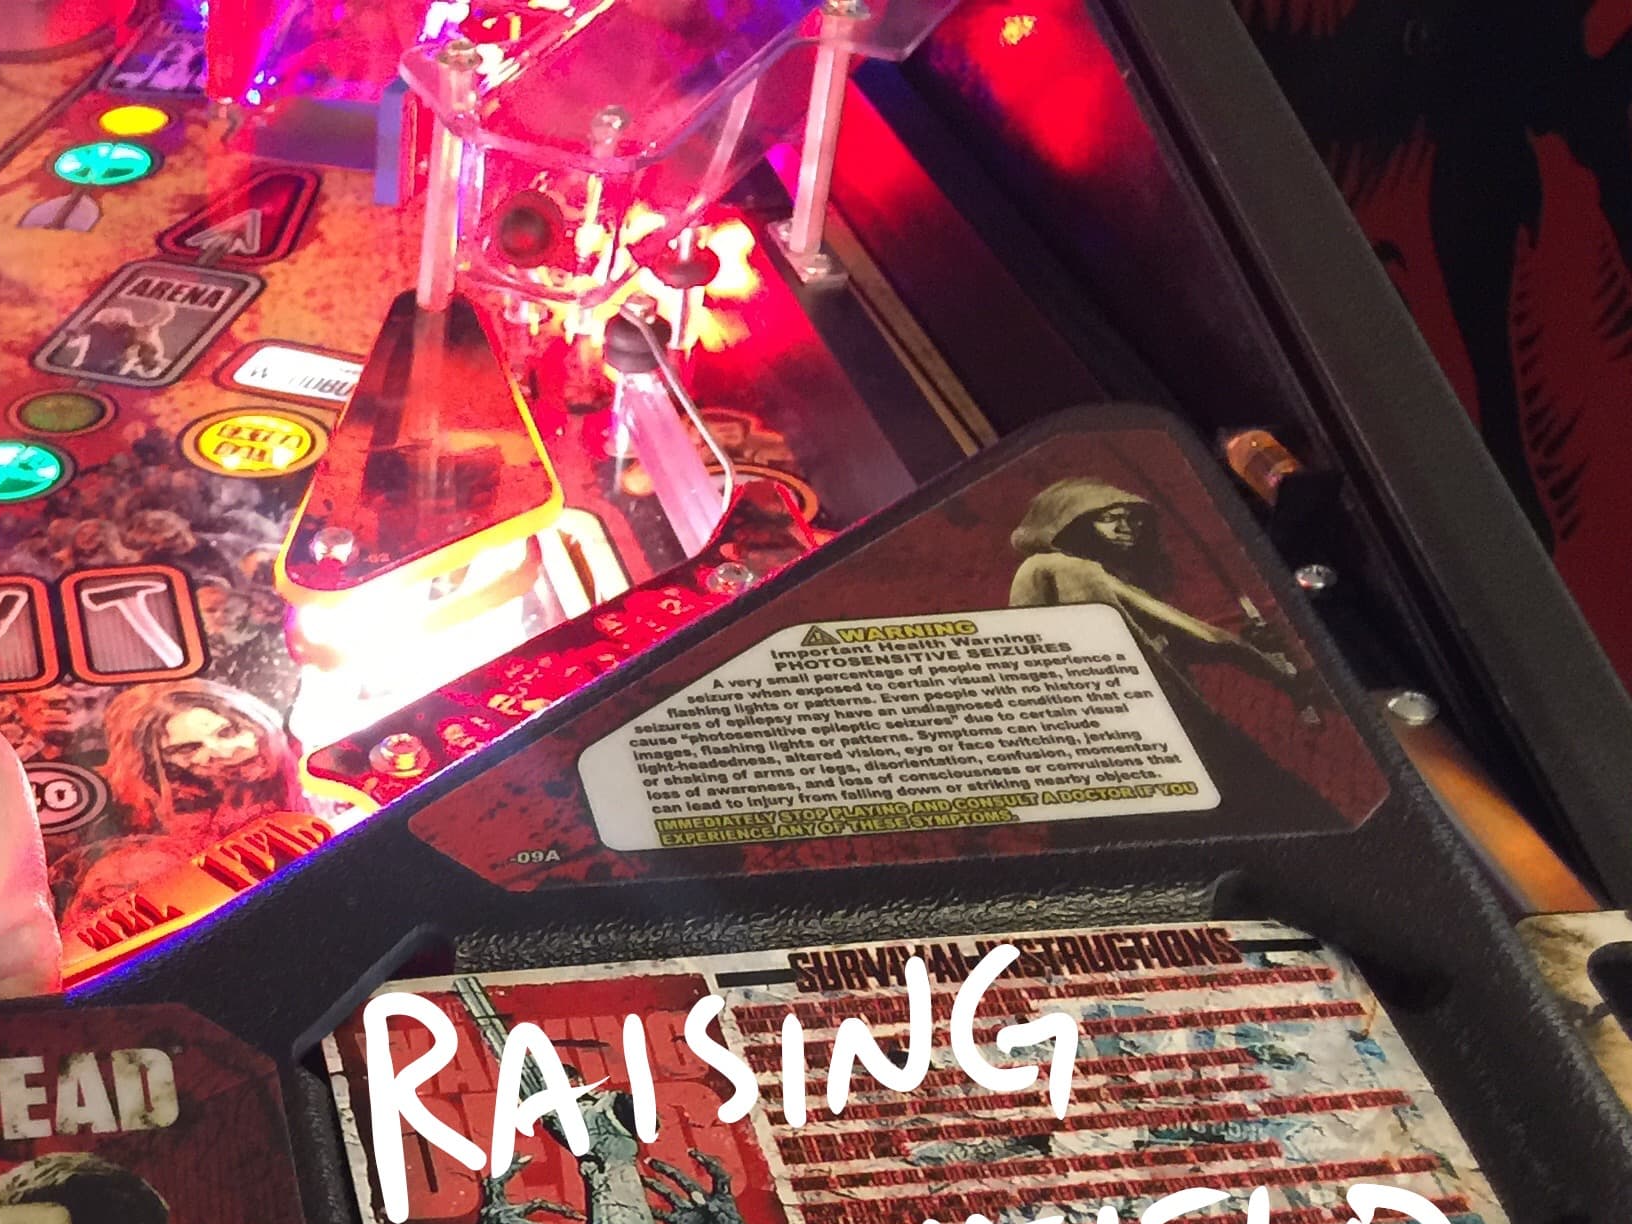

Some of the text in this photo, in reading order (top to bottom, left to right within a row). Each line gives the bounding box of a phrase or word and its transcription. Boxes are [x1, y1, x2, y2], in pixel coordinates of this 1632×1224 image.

[126, 277, 226, 309] ARENA
[770, 633, 1043, 661] Important Health Warning:
[836, 620, 979, 643] WARNING
[713, 653, 1126, 690] A very small percentage of people may experience a
[774, 642, 1072, 672] PHOTOSENSITIVE SEIZURES
[666, 676, 1121, 719] flashing lights or patterns. Even people with no history of
[687, 664, 1140, 708] seizure when exposed to certain visual images, including
[651, 769, 1162, 815] can lead to injury from falling down or striking nearby objects.
[655, 781, 1198, 832] IMMEDIATELY STOP PLAYING AND CONSULT A DOCTOR IF YOU
[659, 809, 1020, 846] EXPERIENCE ANY OF THESE SYMPTOMS.
[509, 850, 561, 864] -09A
